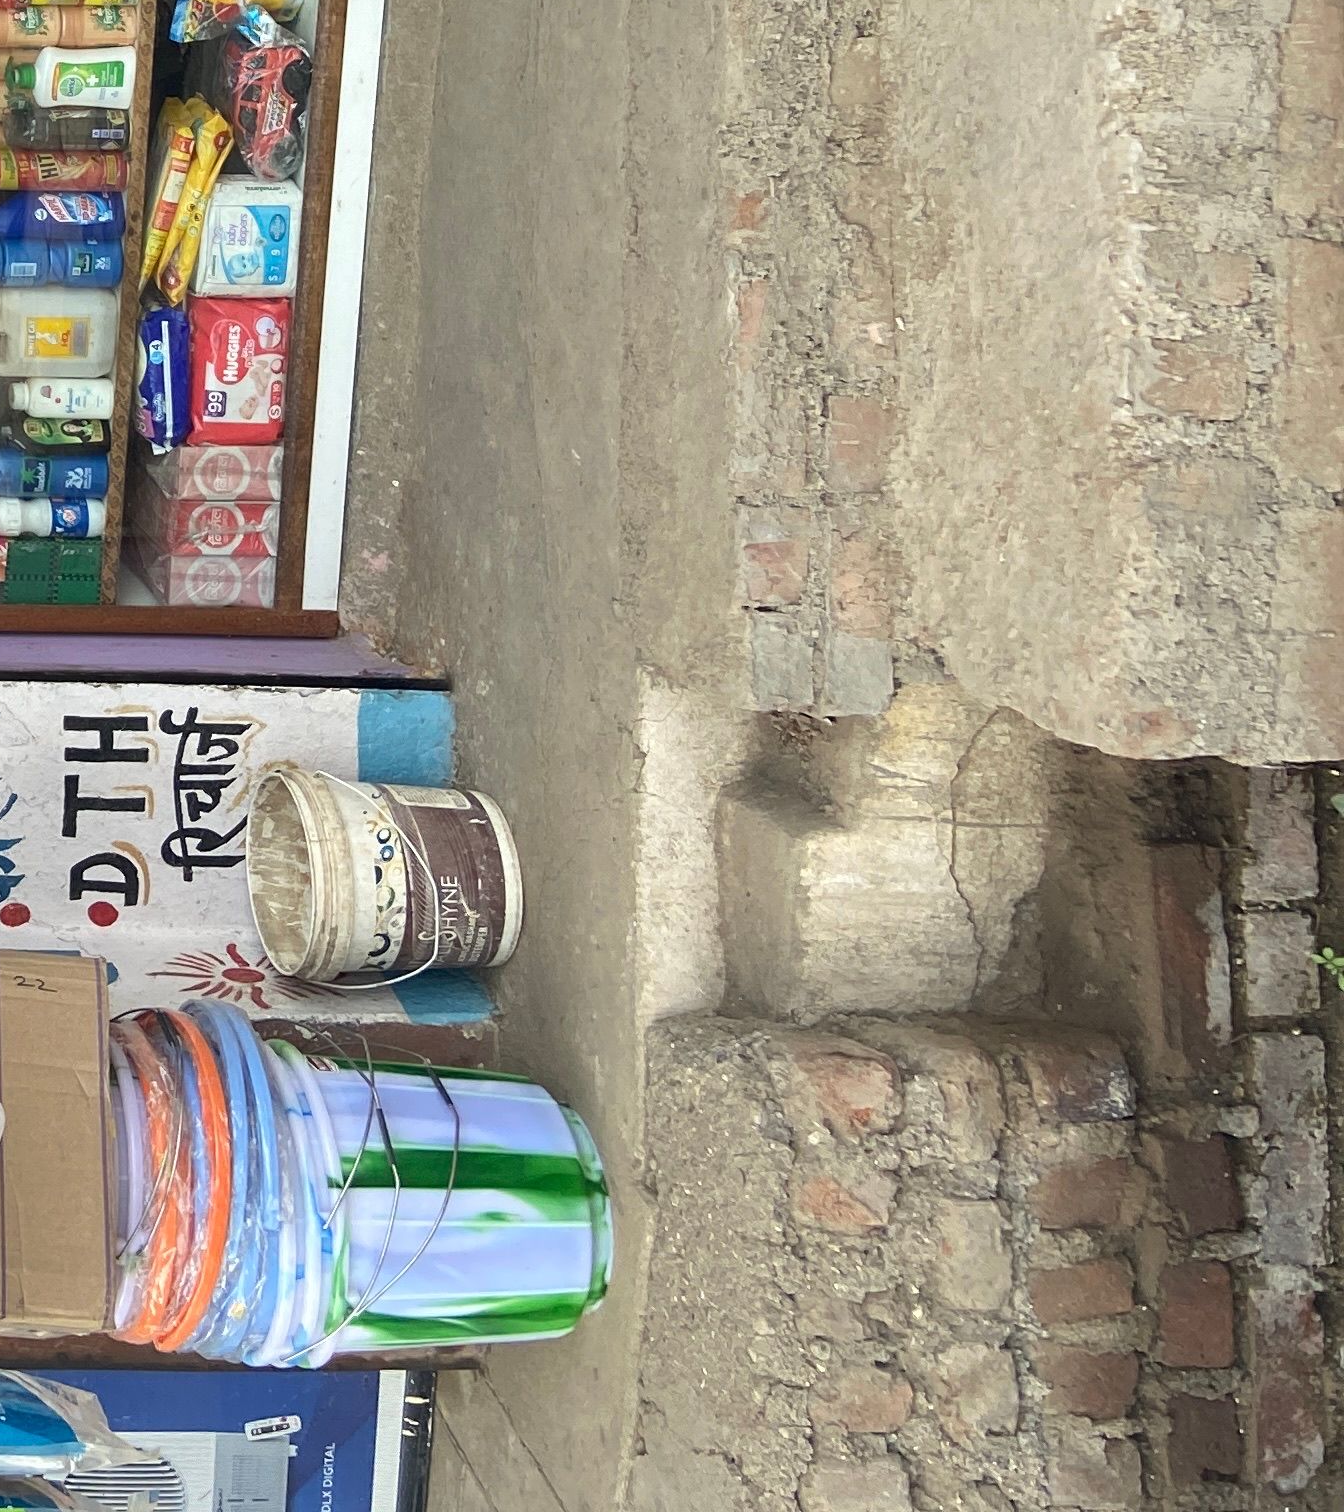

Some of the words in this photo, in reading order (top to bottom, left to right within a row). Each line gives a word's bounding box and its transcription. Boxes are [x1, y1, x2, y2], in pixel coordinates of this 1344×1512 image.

[38, 154, 58, 179] HIT
[226, 224, 241, 246] baby
[238, 214, 250, 246] diapers
[223, 325, 241, 381] HUGGIES
[208, 392, 223, 413] 99
[61, 708, 157, 906] DTH
[159, 707, 252, 881] रिचार्ज
[323, 1443, 336, 1487] DIGITAL
